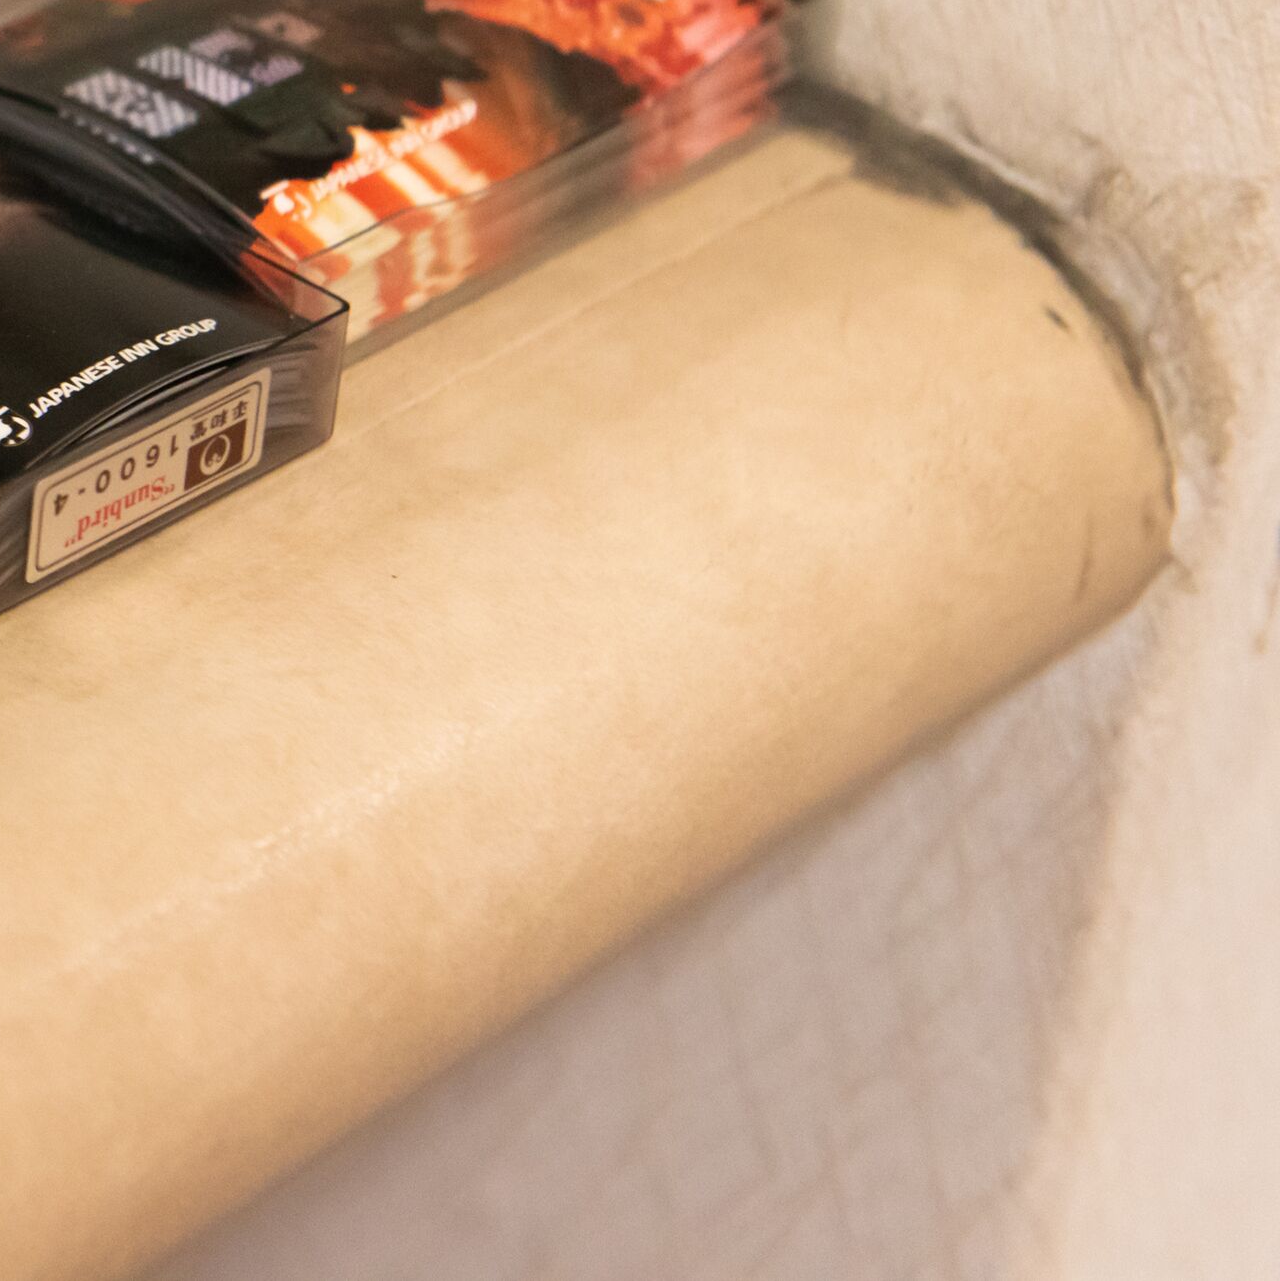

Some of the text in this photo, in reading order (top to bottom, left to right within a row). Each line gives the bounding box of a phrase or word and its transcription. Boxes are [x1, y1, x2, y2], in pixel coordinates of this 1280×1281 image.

[28, 318, 217, 418] JAPANESE INN GROUP
